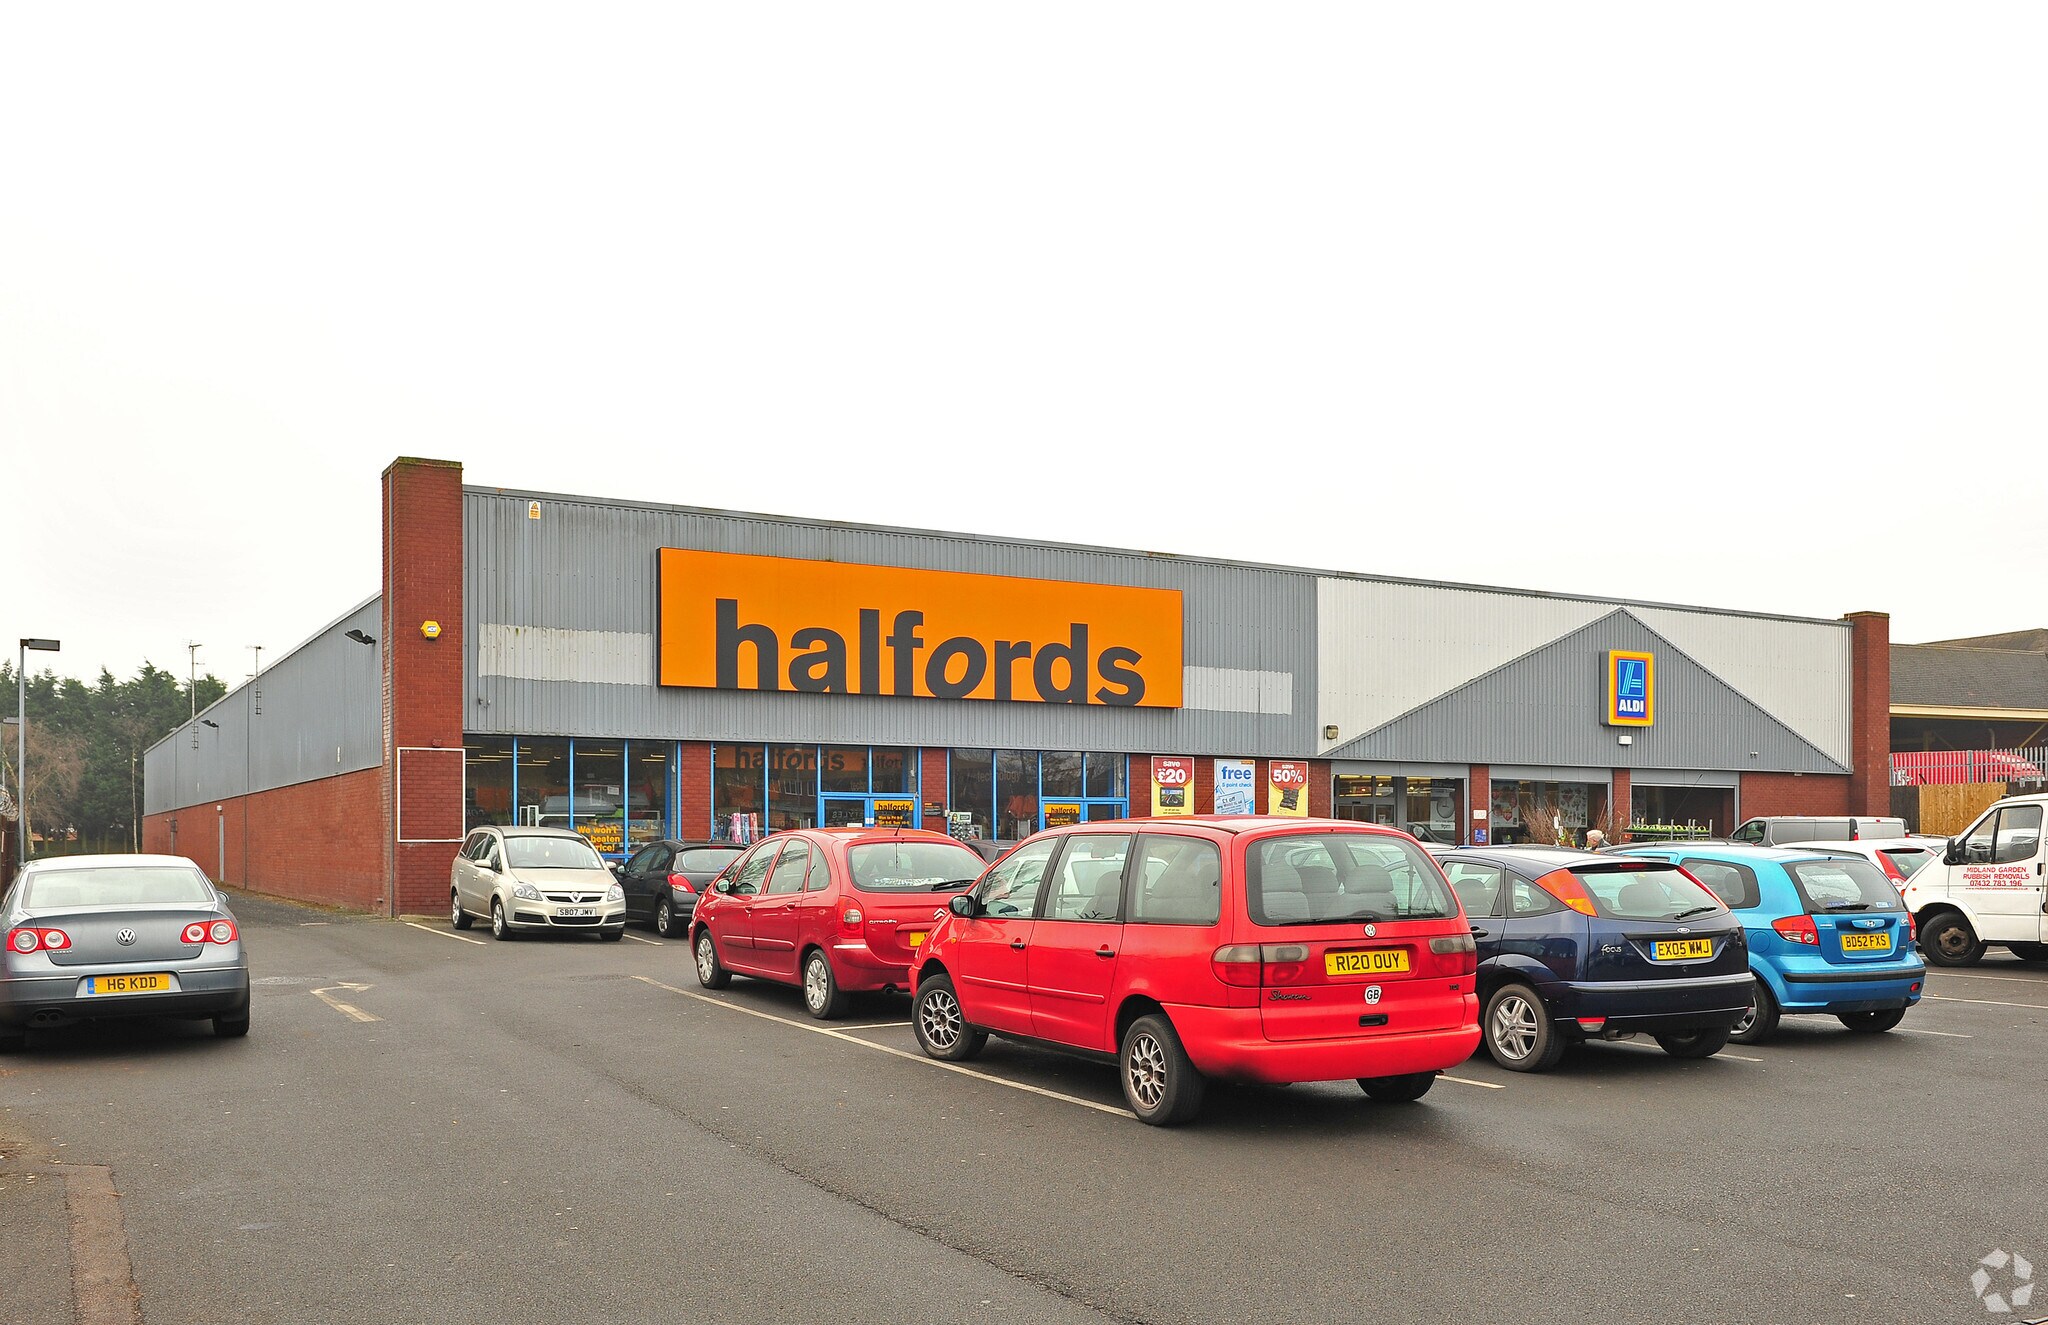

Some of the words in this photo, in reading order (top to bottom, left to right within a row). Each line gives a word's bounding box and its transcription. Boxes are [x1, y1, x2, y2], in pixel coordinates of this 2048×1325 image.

[715, 597, 1147, 707] halfords
[1618, 699, 1645, 712] ALDI
[1157, 768, 1186, 783] £20
[1221, 766, 1252, 780] free
[1273, 769, 1303, 783] 50%
[878, 803, 909, 811] halfords
[577, 826, 591, 834] We
[593, 826, 617, 834] won't
[590, 835, 621, 843] beaten
[595, 843, 615, 852] rice!
[1658, 942, 1686, 956] EX05
[1688, 940, 1710, 954] WMJ
[1845, 935, 1868, 948] BD52
[1870, 934, 1887, 946] FXS
[1336, 954, 1370, 971] R120
[1374, 953, 1401, 968] OUY
[107, 978, 126, 990] H6
[130, 976, 158, 989] KDD
[1366, 989, 1380, 1000] GB
